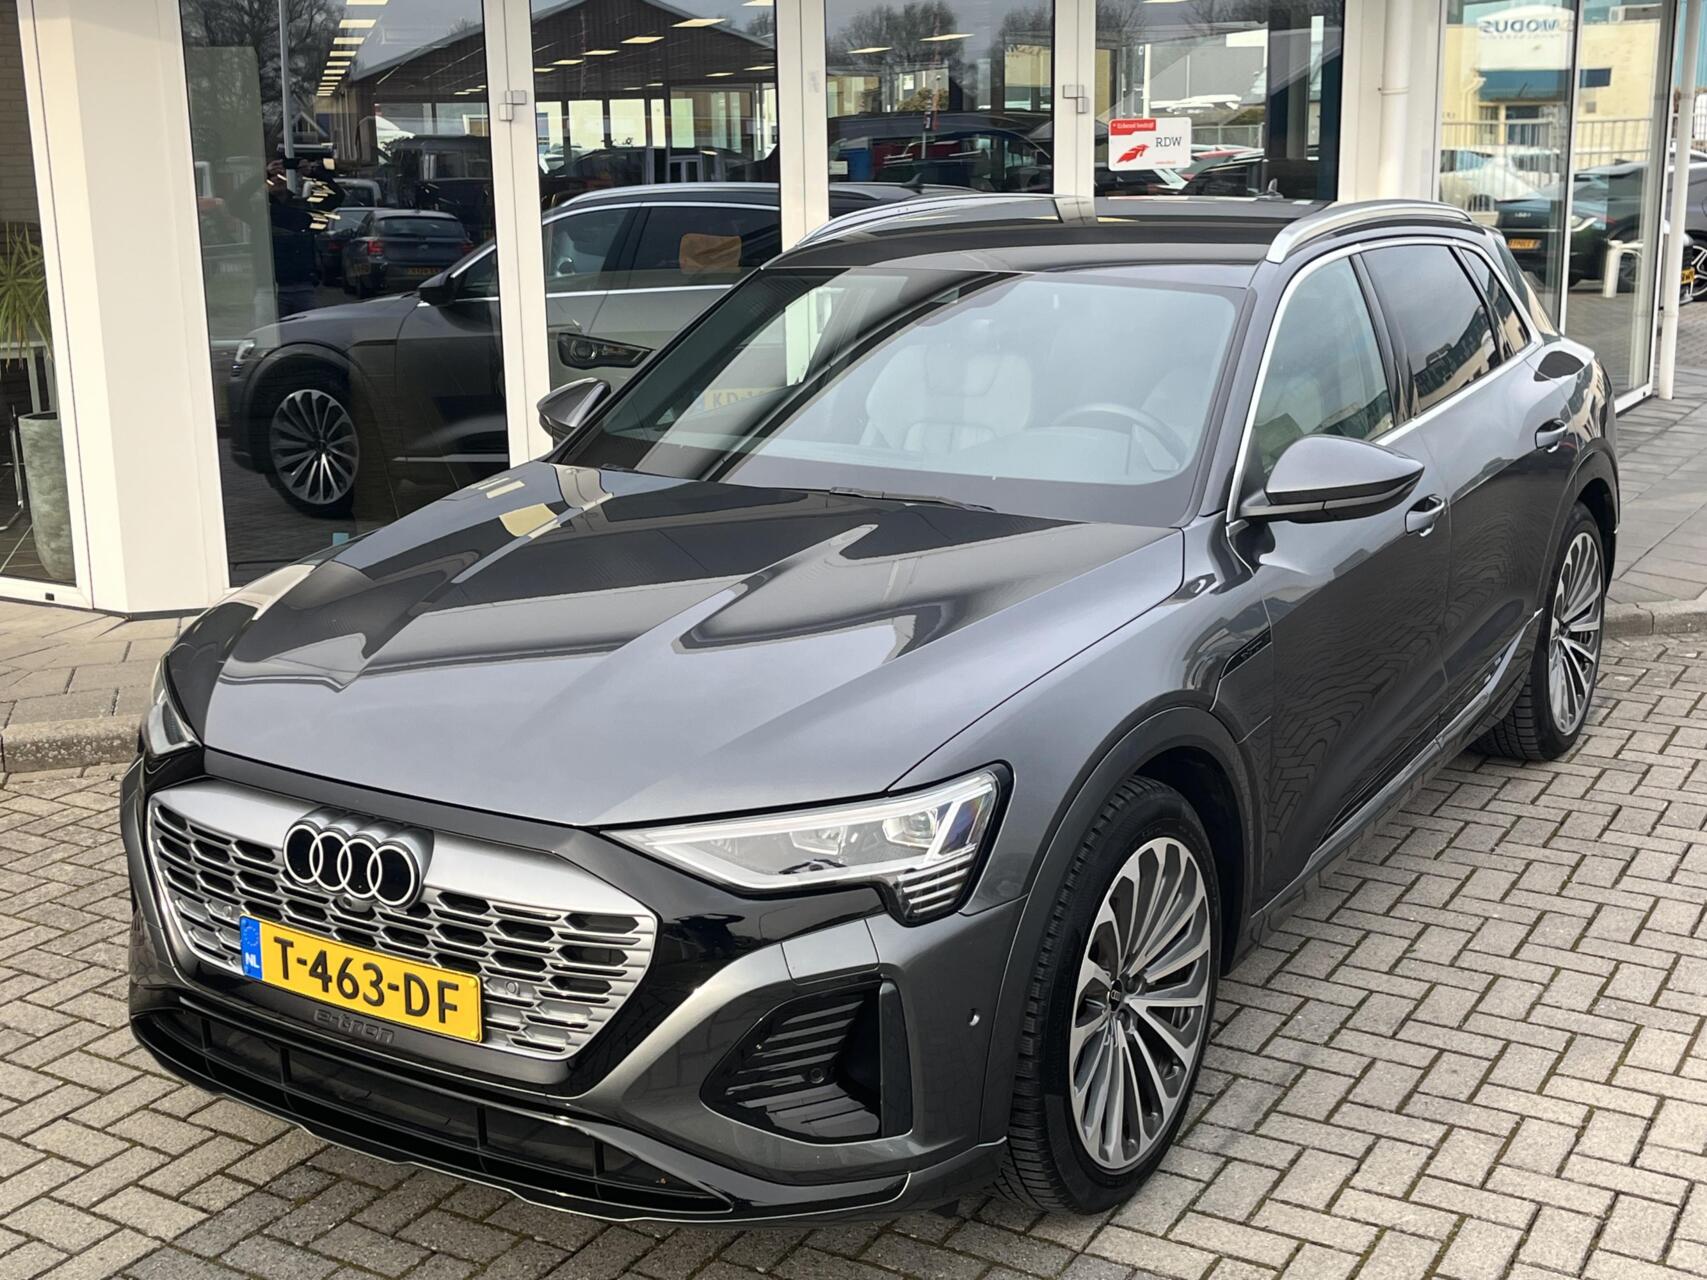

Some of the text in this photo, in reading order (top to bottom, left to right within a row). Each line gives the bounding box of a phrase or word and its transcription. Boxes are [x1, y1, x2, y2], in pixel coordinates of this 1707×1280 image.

[1155, 137, 1182, 147] RDW
[245, 952, 260, 969] NL
[274, 936, 459, 1024] T-463-DF
